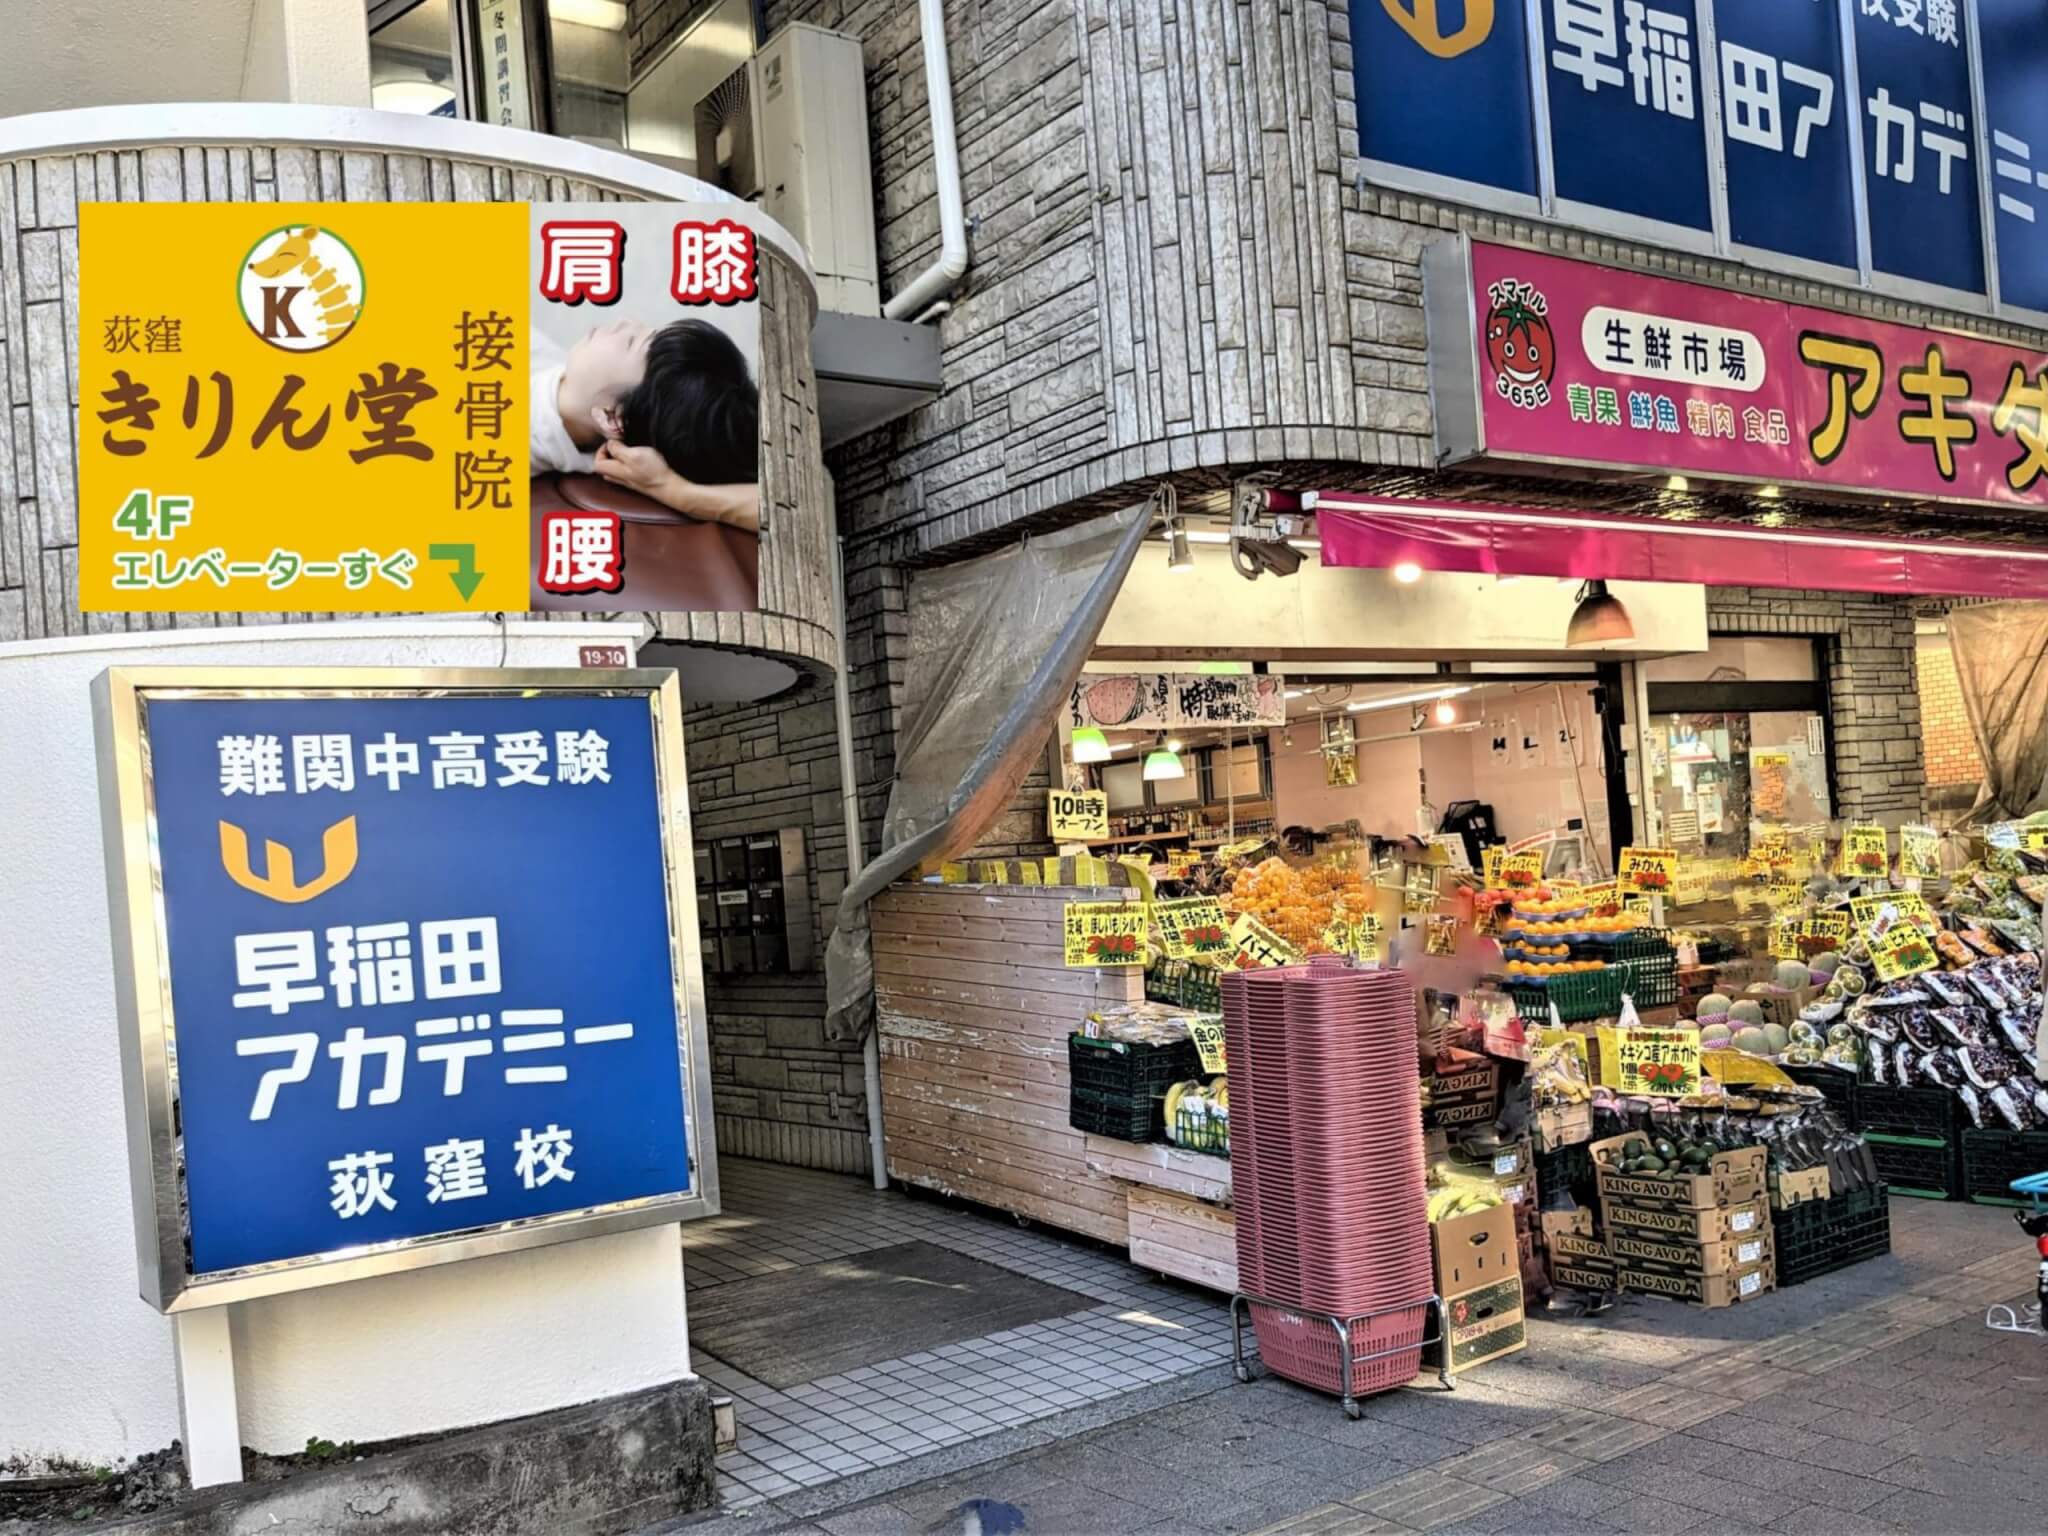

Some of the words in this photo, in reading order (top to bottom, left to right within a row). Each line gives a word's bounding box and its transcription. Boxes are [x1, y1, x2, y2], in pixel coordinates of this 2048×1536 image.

[1488, 278, 1548, 316] スマイル
[1604, 319, 1747, 382] 生鮮市場
[1496, 374, 1551, 408] 365日
[1567, 384, 1621, 425] 青果
[1628, 391, 1680, 432] 鮮魚
[1687, 399, 1736, 439] 精肉
[1743, 406, 1790, 445] 食品
[584, 650, 625, 665] 19-10
[217, 729, 612, 797] 難関中高受験
[1053, 796, 1104, 817] 10時
[1629, 858, 1665, 872] みかん
[233, 916, 502, 1015] 早稲田
[236, 1008, 635, 1122] アカデミー
[328, 1124, 576, 1220] 荻窪校
